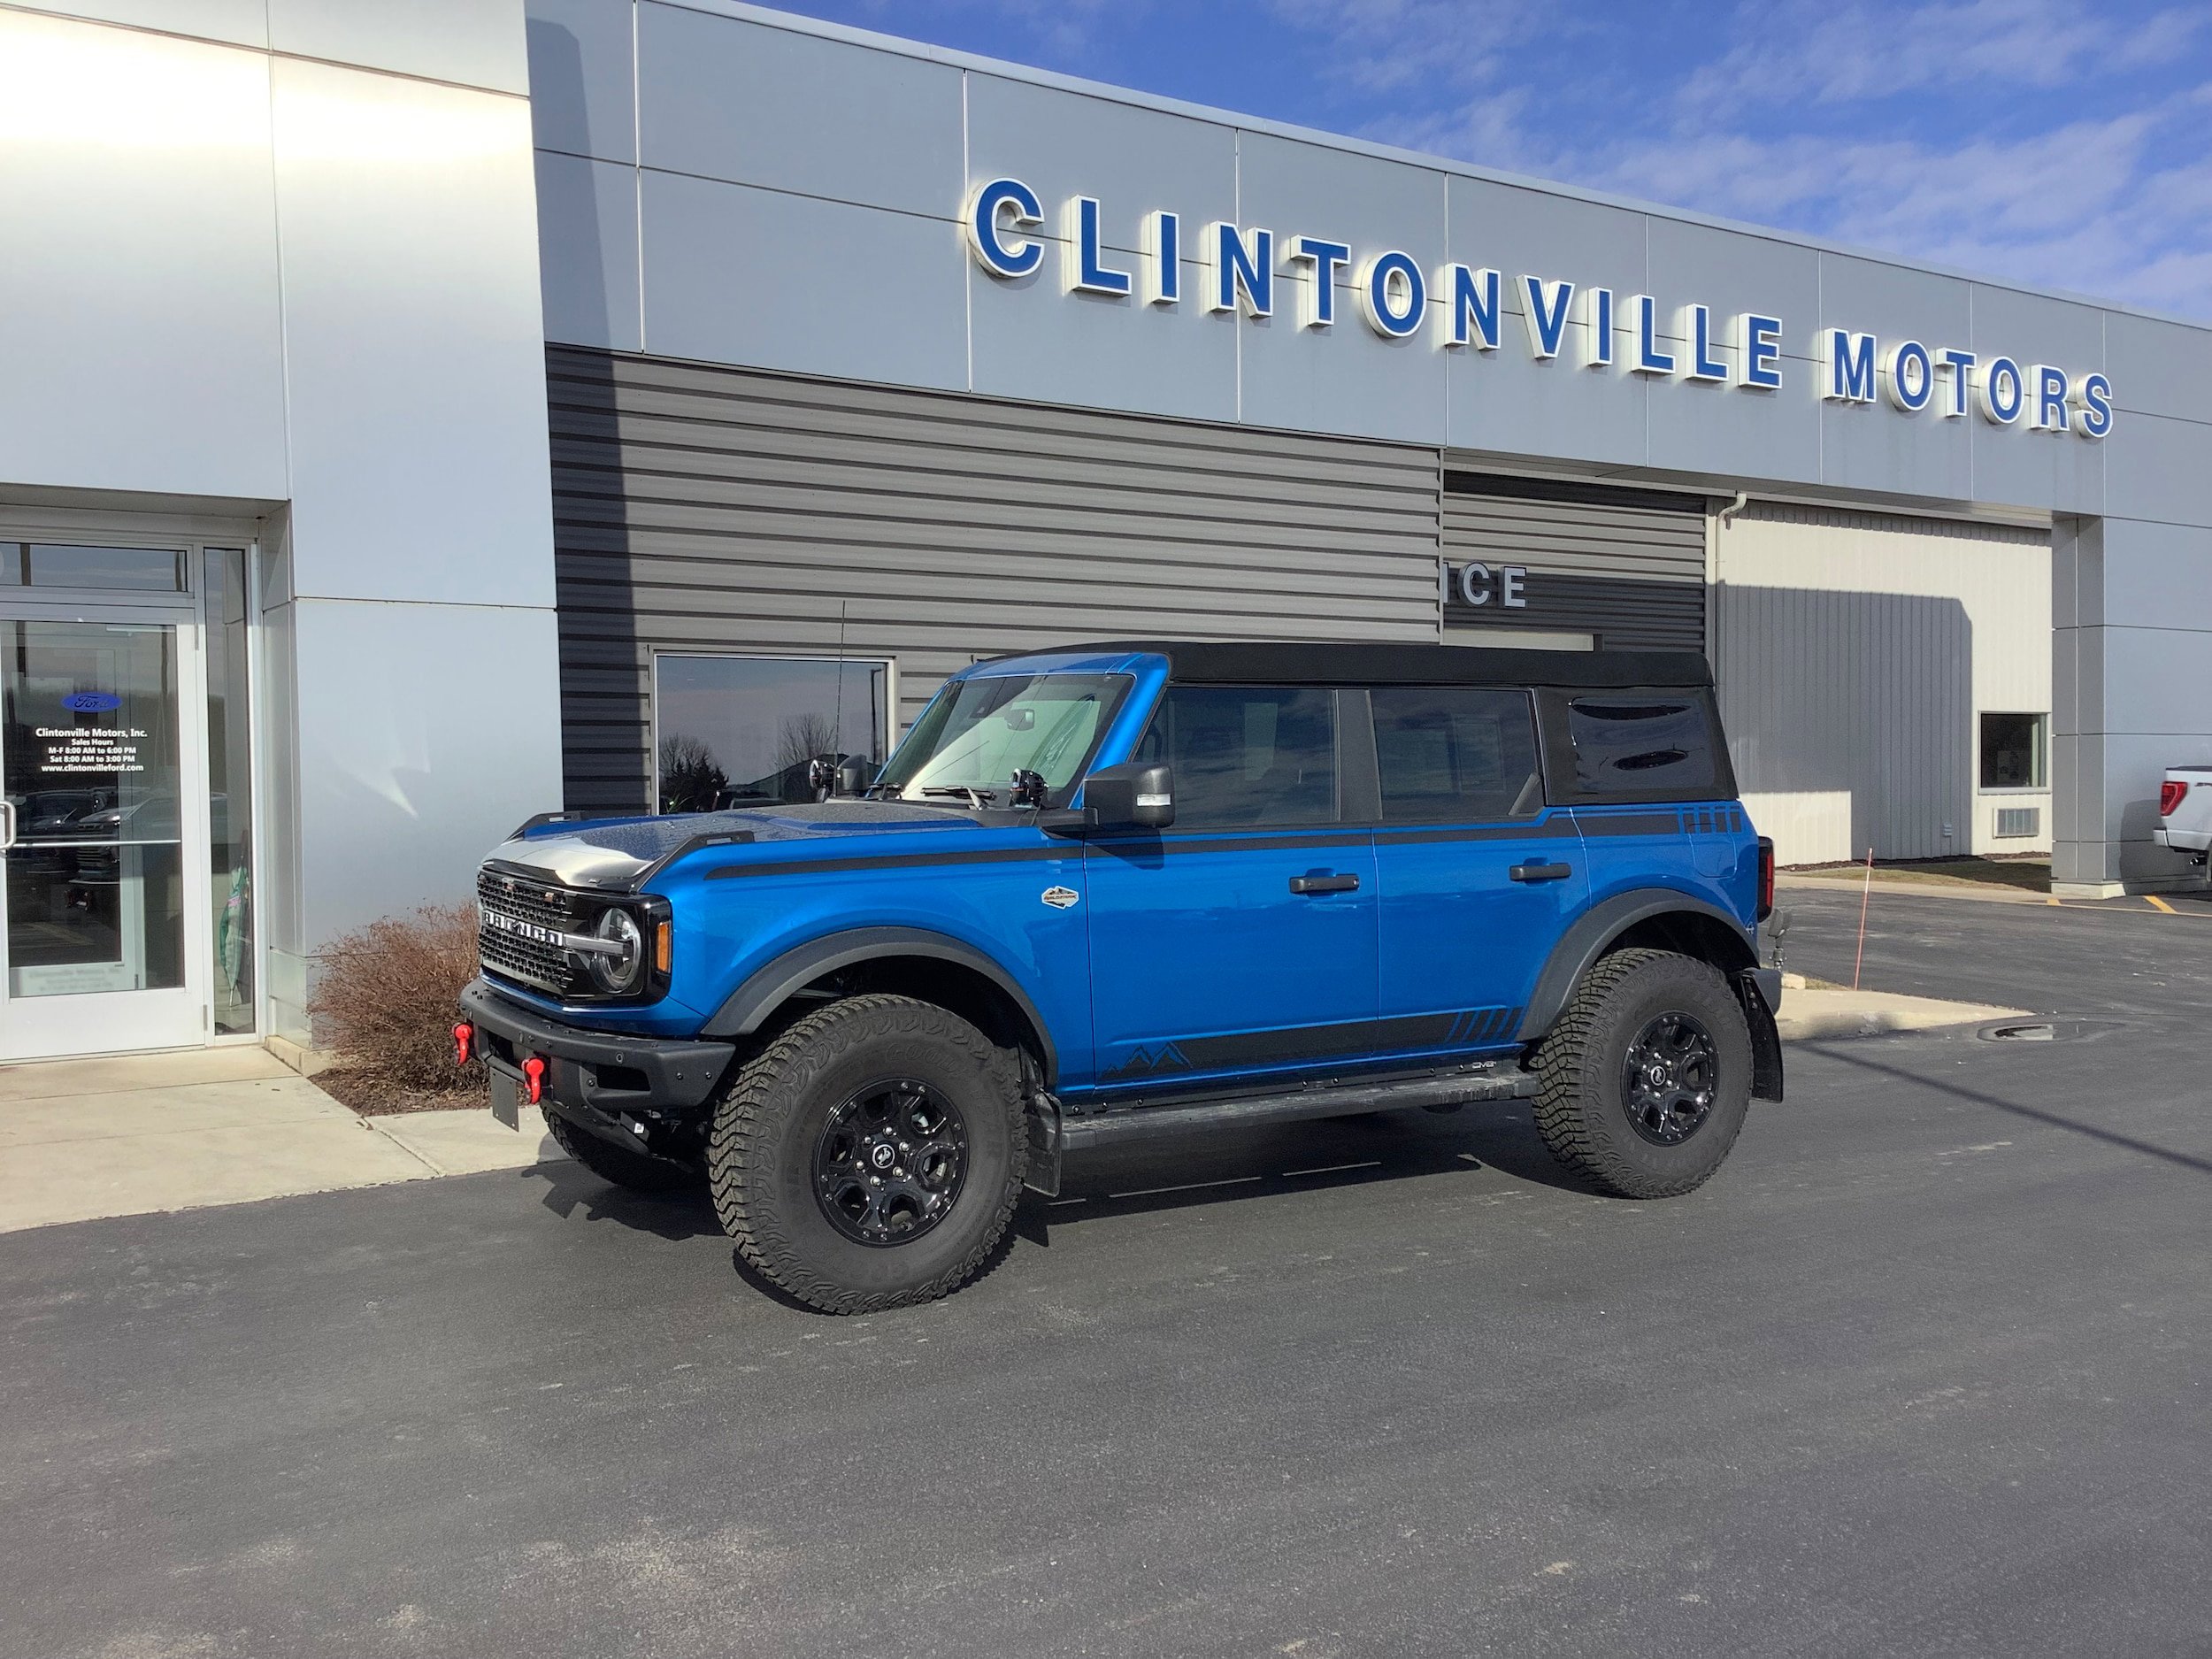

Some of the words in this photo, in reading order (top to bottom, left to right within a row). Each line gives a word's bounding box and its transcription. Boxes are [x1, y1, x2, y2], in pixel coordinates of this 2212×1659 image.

[967, 177, 1782, 389] CLINTONVILLE
[1823, 326, 2113, 439] MOTORS
[74, 695, 111, 708] Ford
[35, 727, 90, 737] Clintonville
[91, 728, 128, 738] Motors,
[130, 728, 148, 737] Inc.
